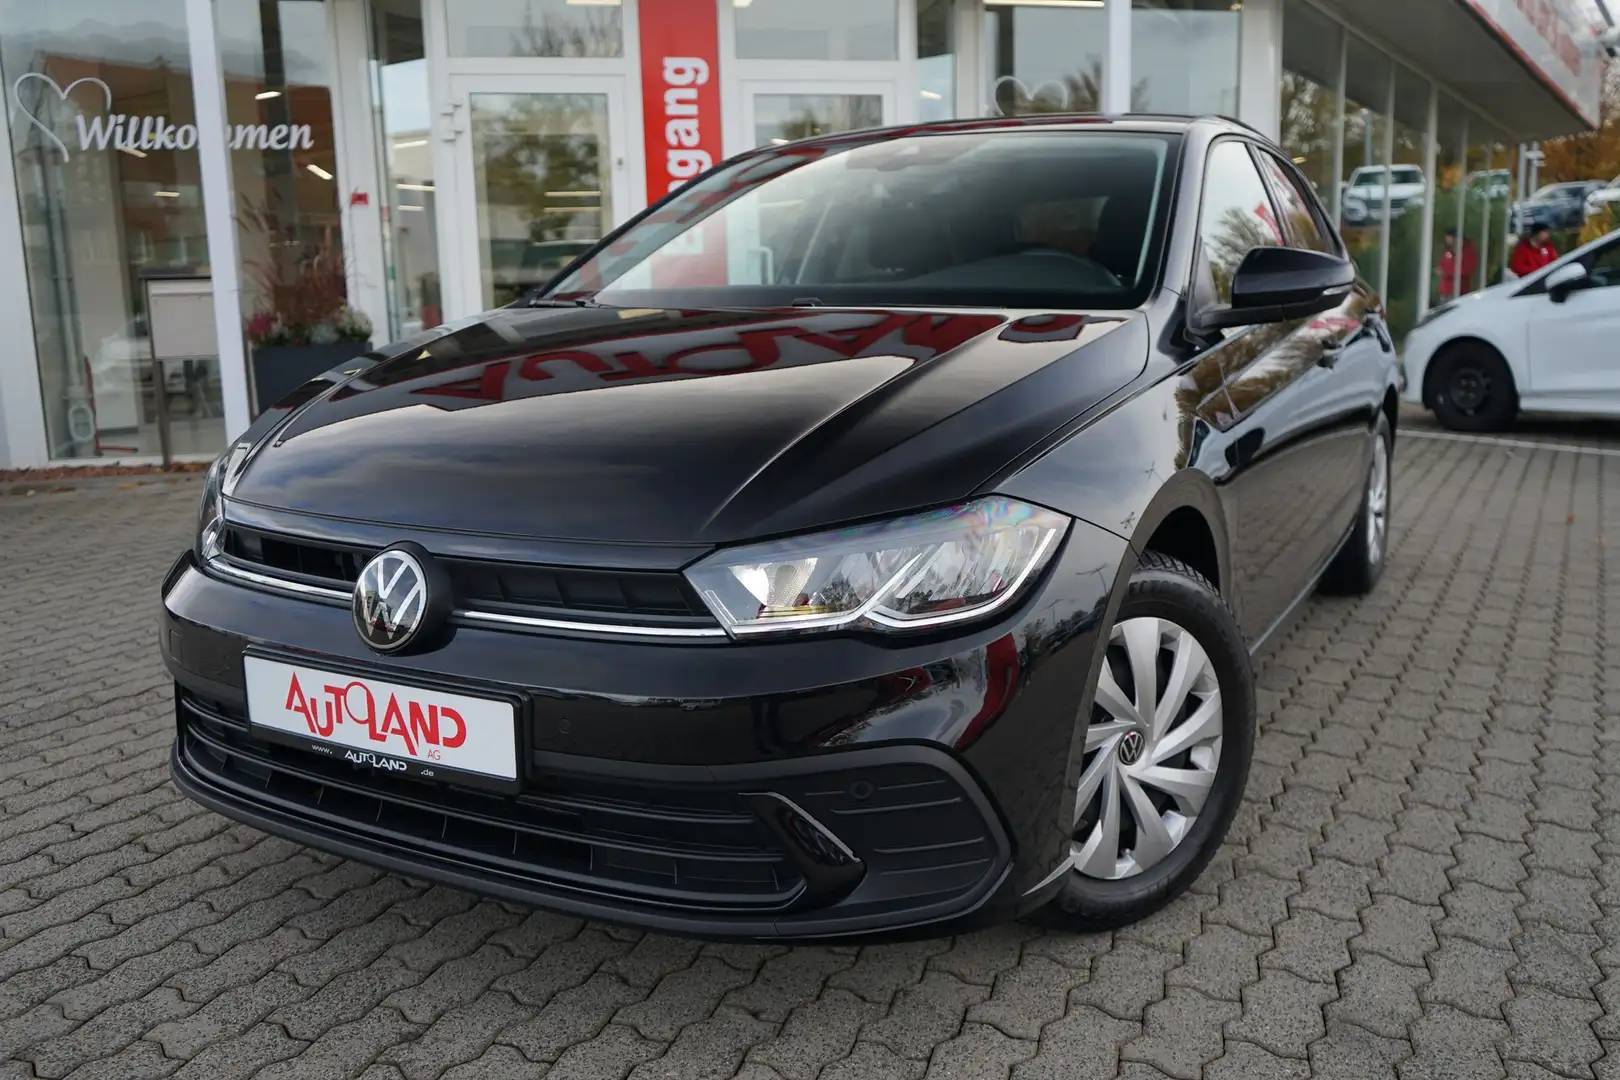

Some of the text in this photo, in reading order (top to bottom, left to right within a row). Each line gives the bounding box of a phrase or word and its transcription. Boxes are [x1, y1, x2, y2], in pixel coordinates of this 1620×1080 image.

[75, 114, 315, 151] Willkomen
[285, 671, 467, 756] AUTOLAND
[427, 749, 441, 761] AG
[1120, 732, 1145, 764] VW
